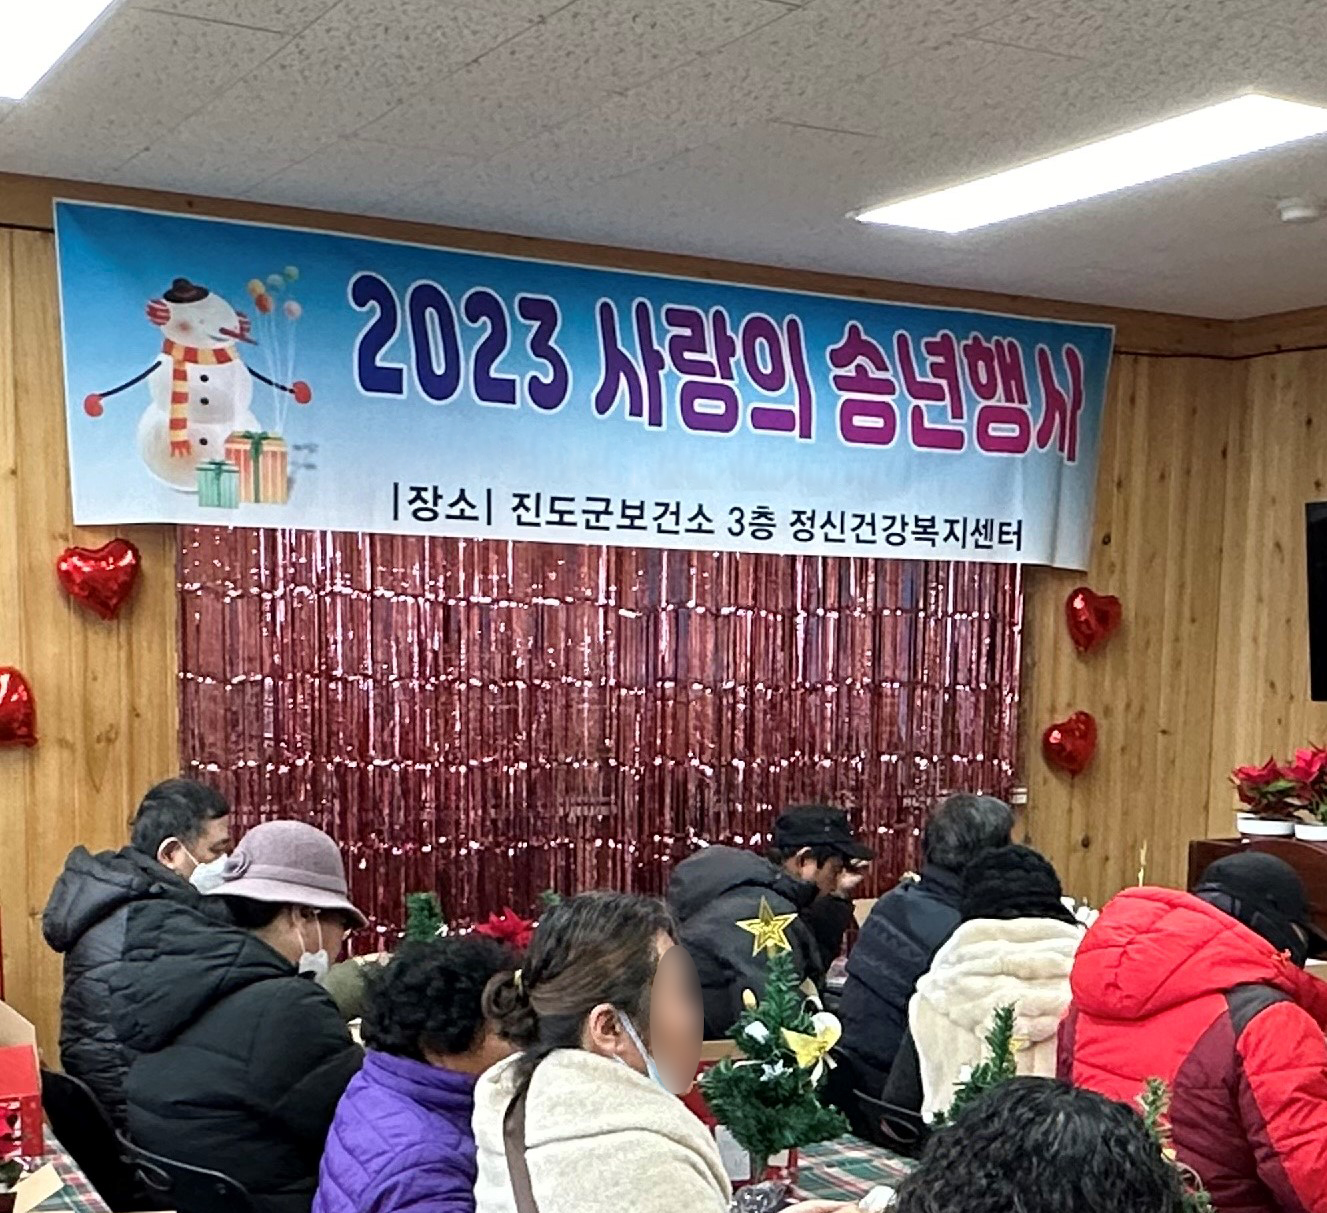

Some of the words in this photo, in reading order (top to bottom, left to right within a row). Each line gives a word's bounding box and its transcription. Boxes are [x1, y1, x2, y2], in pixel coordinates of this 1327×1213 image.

[348, 272, 571, 411] 2023
[594, 298, 815, 443] 사랑의
[826, 320, 1084, 465] 송년행사
[511, 492, 716, 536] 진도군보건소
[727, 506, 777, 541] 3층
[789, 509, 1023, 551] 정신건강복지센터
